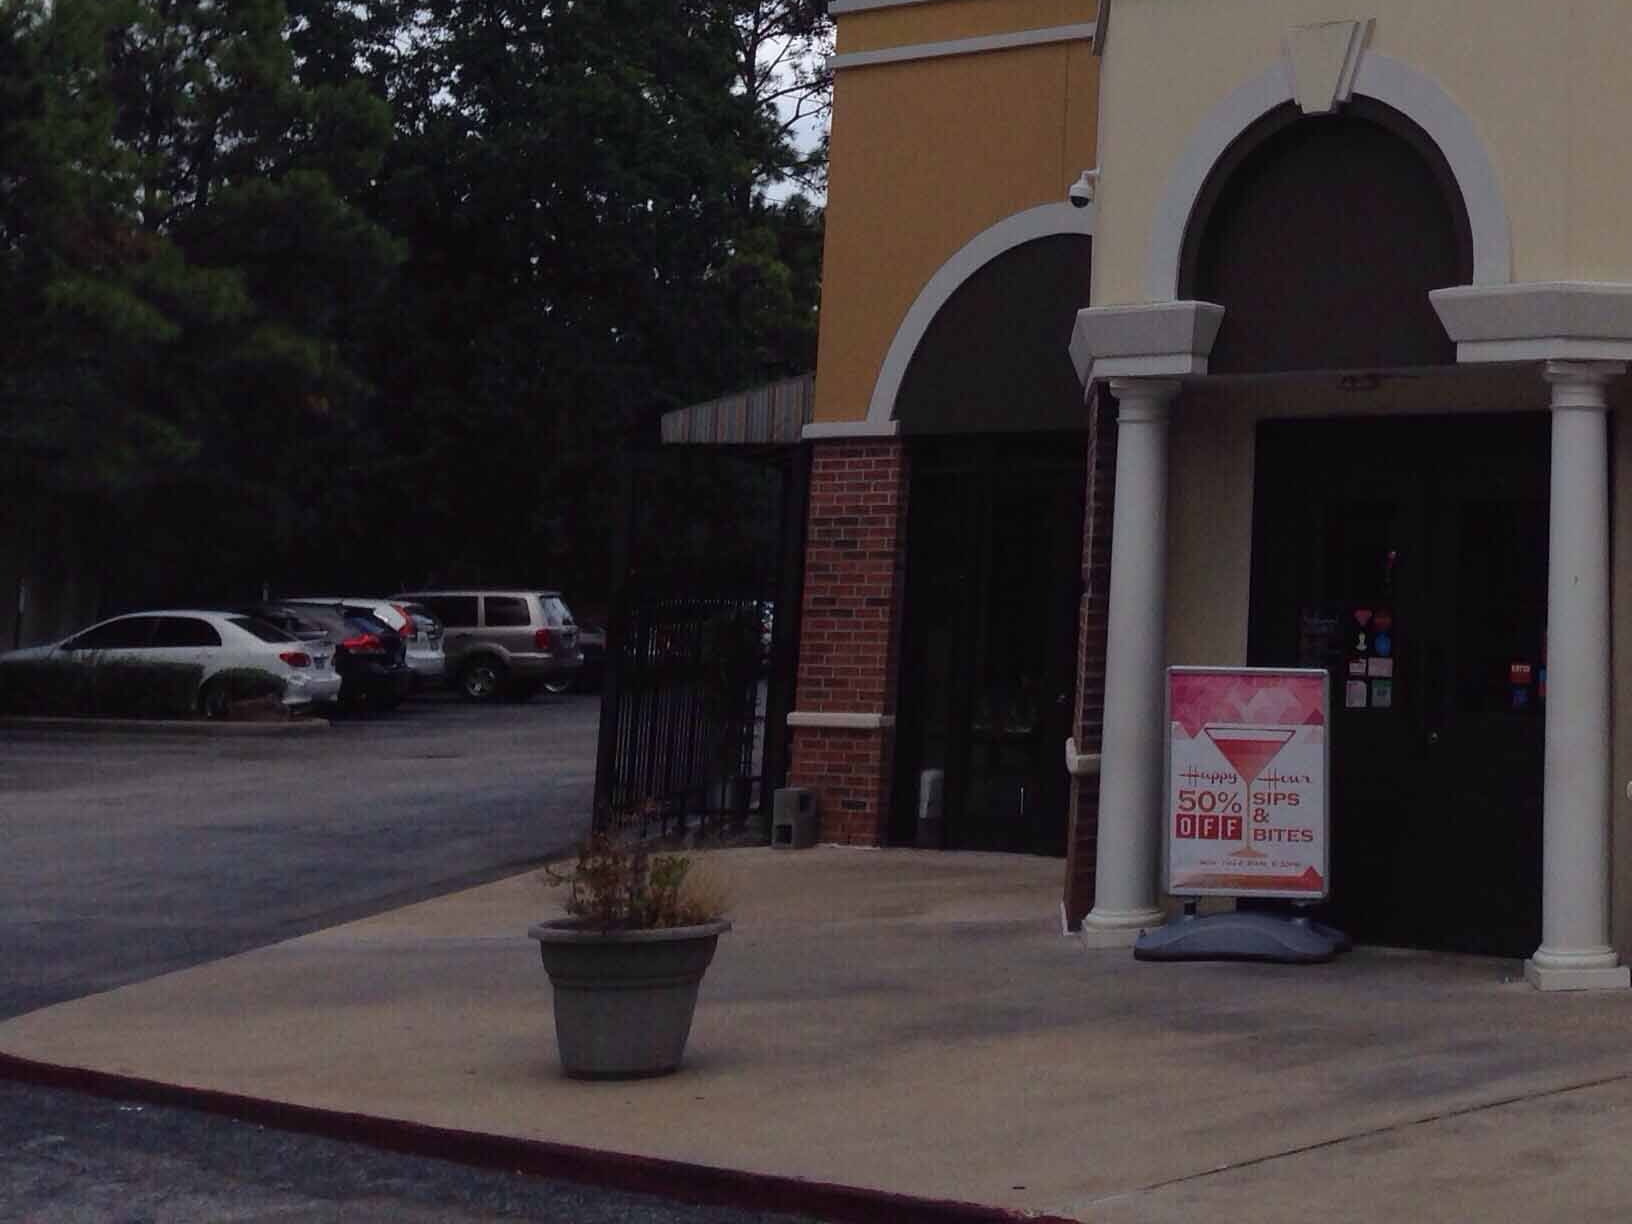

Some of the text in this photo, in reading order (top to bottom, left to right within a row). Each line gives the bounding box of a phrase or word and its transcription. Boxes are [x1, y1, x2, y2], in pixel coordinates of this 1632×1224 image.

[1178, 790, 1242, 814] 50%
[1252, 791, 1300, 806] SIPS
[1253, 808, 1269, 823] &
[1177, 815, 1241, 839] OFF
[1252, 828, 1314, 843] BITES
